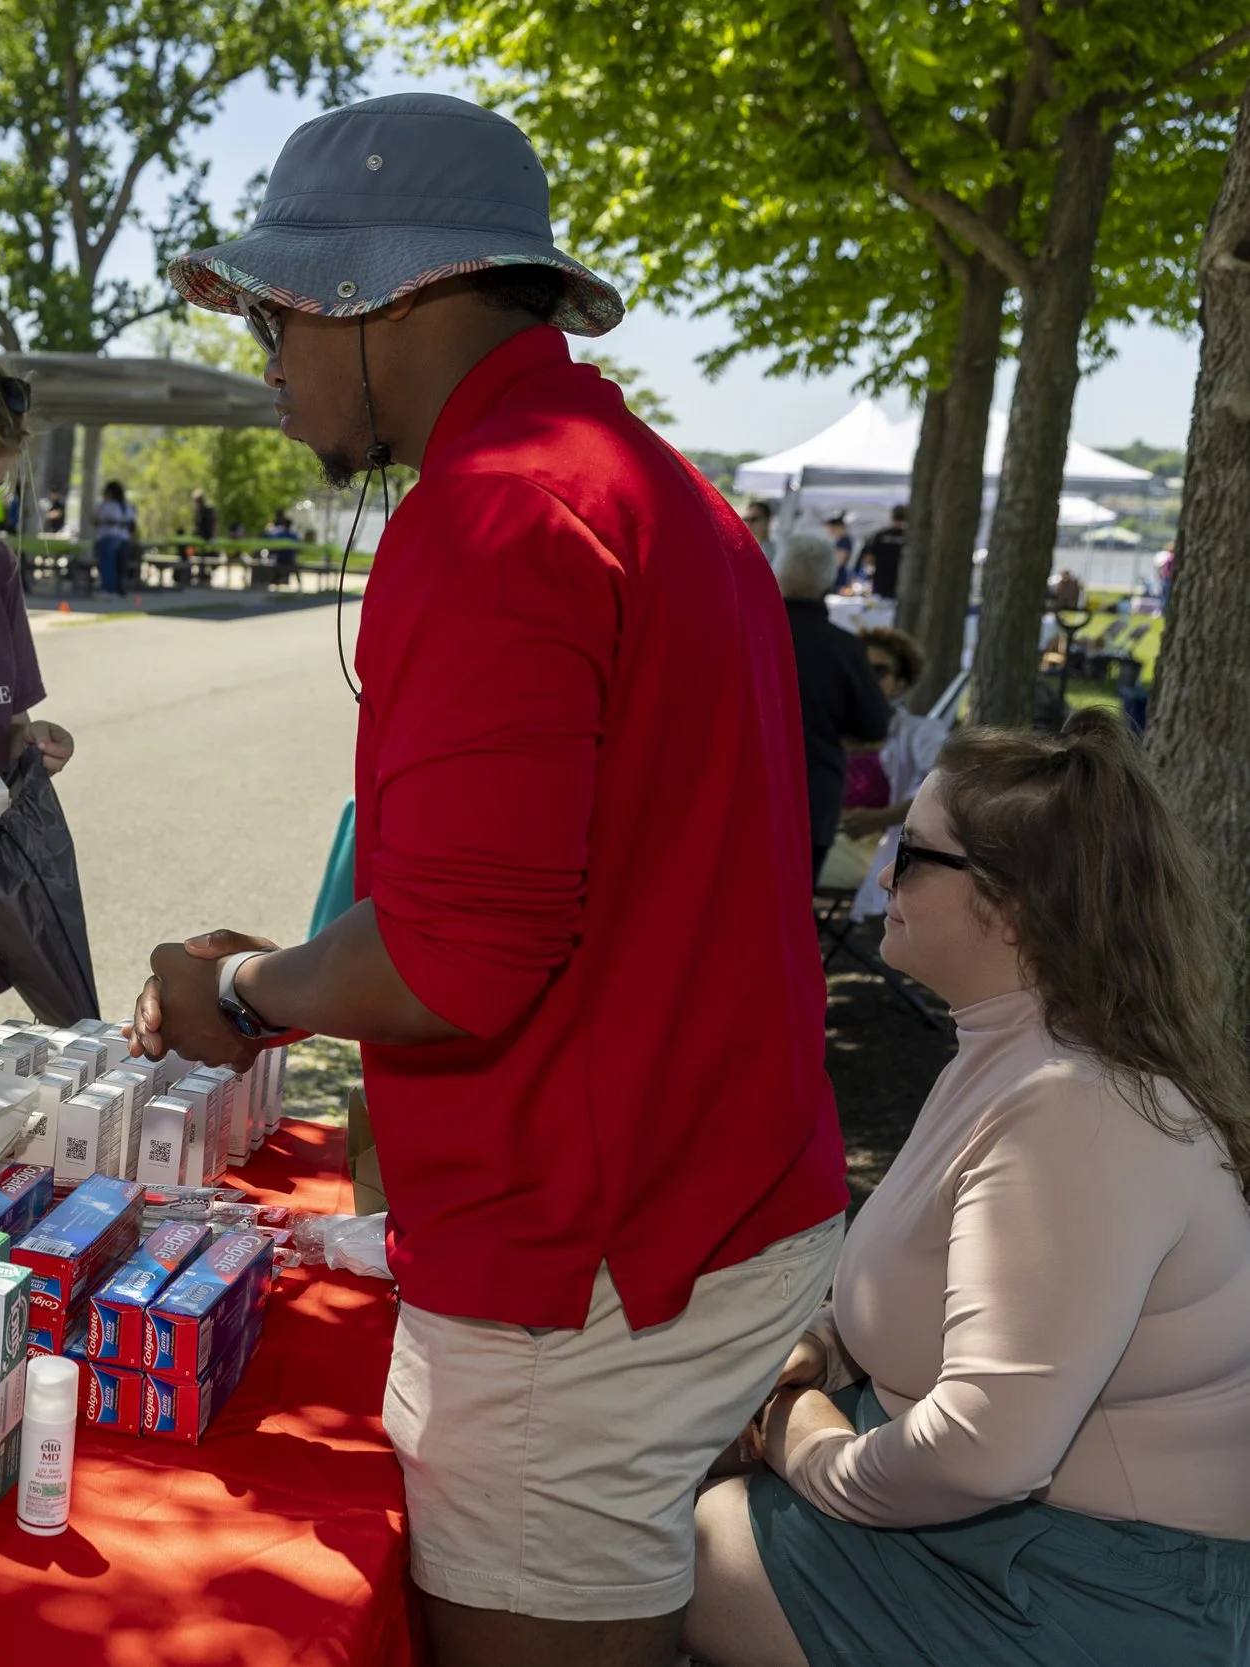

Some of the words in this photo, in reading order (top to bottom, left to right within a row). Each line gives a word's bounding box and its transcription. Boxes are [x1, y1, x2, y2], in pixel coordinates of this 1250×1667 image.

[1, 1166, 45, 1192] Colgate
[155, 1225, 201, 1260] Colgate
[214, 1235, 262, 1273] Colgate
[30, 1282, 47, 1291] Cavi
[30, 1296, 60, 1311] Colga
[10, 1289, 24, 1359] Tom's
[87, 1312, 99, 1355] Colgate
[143, 1322, 154, 1366] Colgate
[86, 1377, 98, 1420] Colgate
[103, 1386, 111, 1408] Cavity
[143, 1386, 155, 1429] Colgate
[40, 1441, 61, 1452] elta
[42, 1453, 60, 1461] MD
[35, 1472, 63, 1480] Recovery
